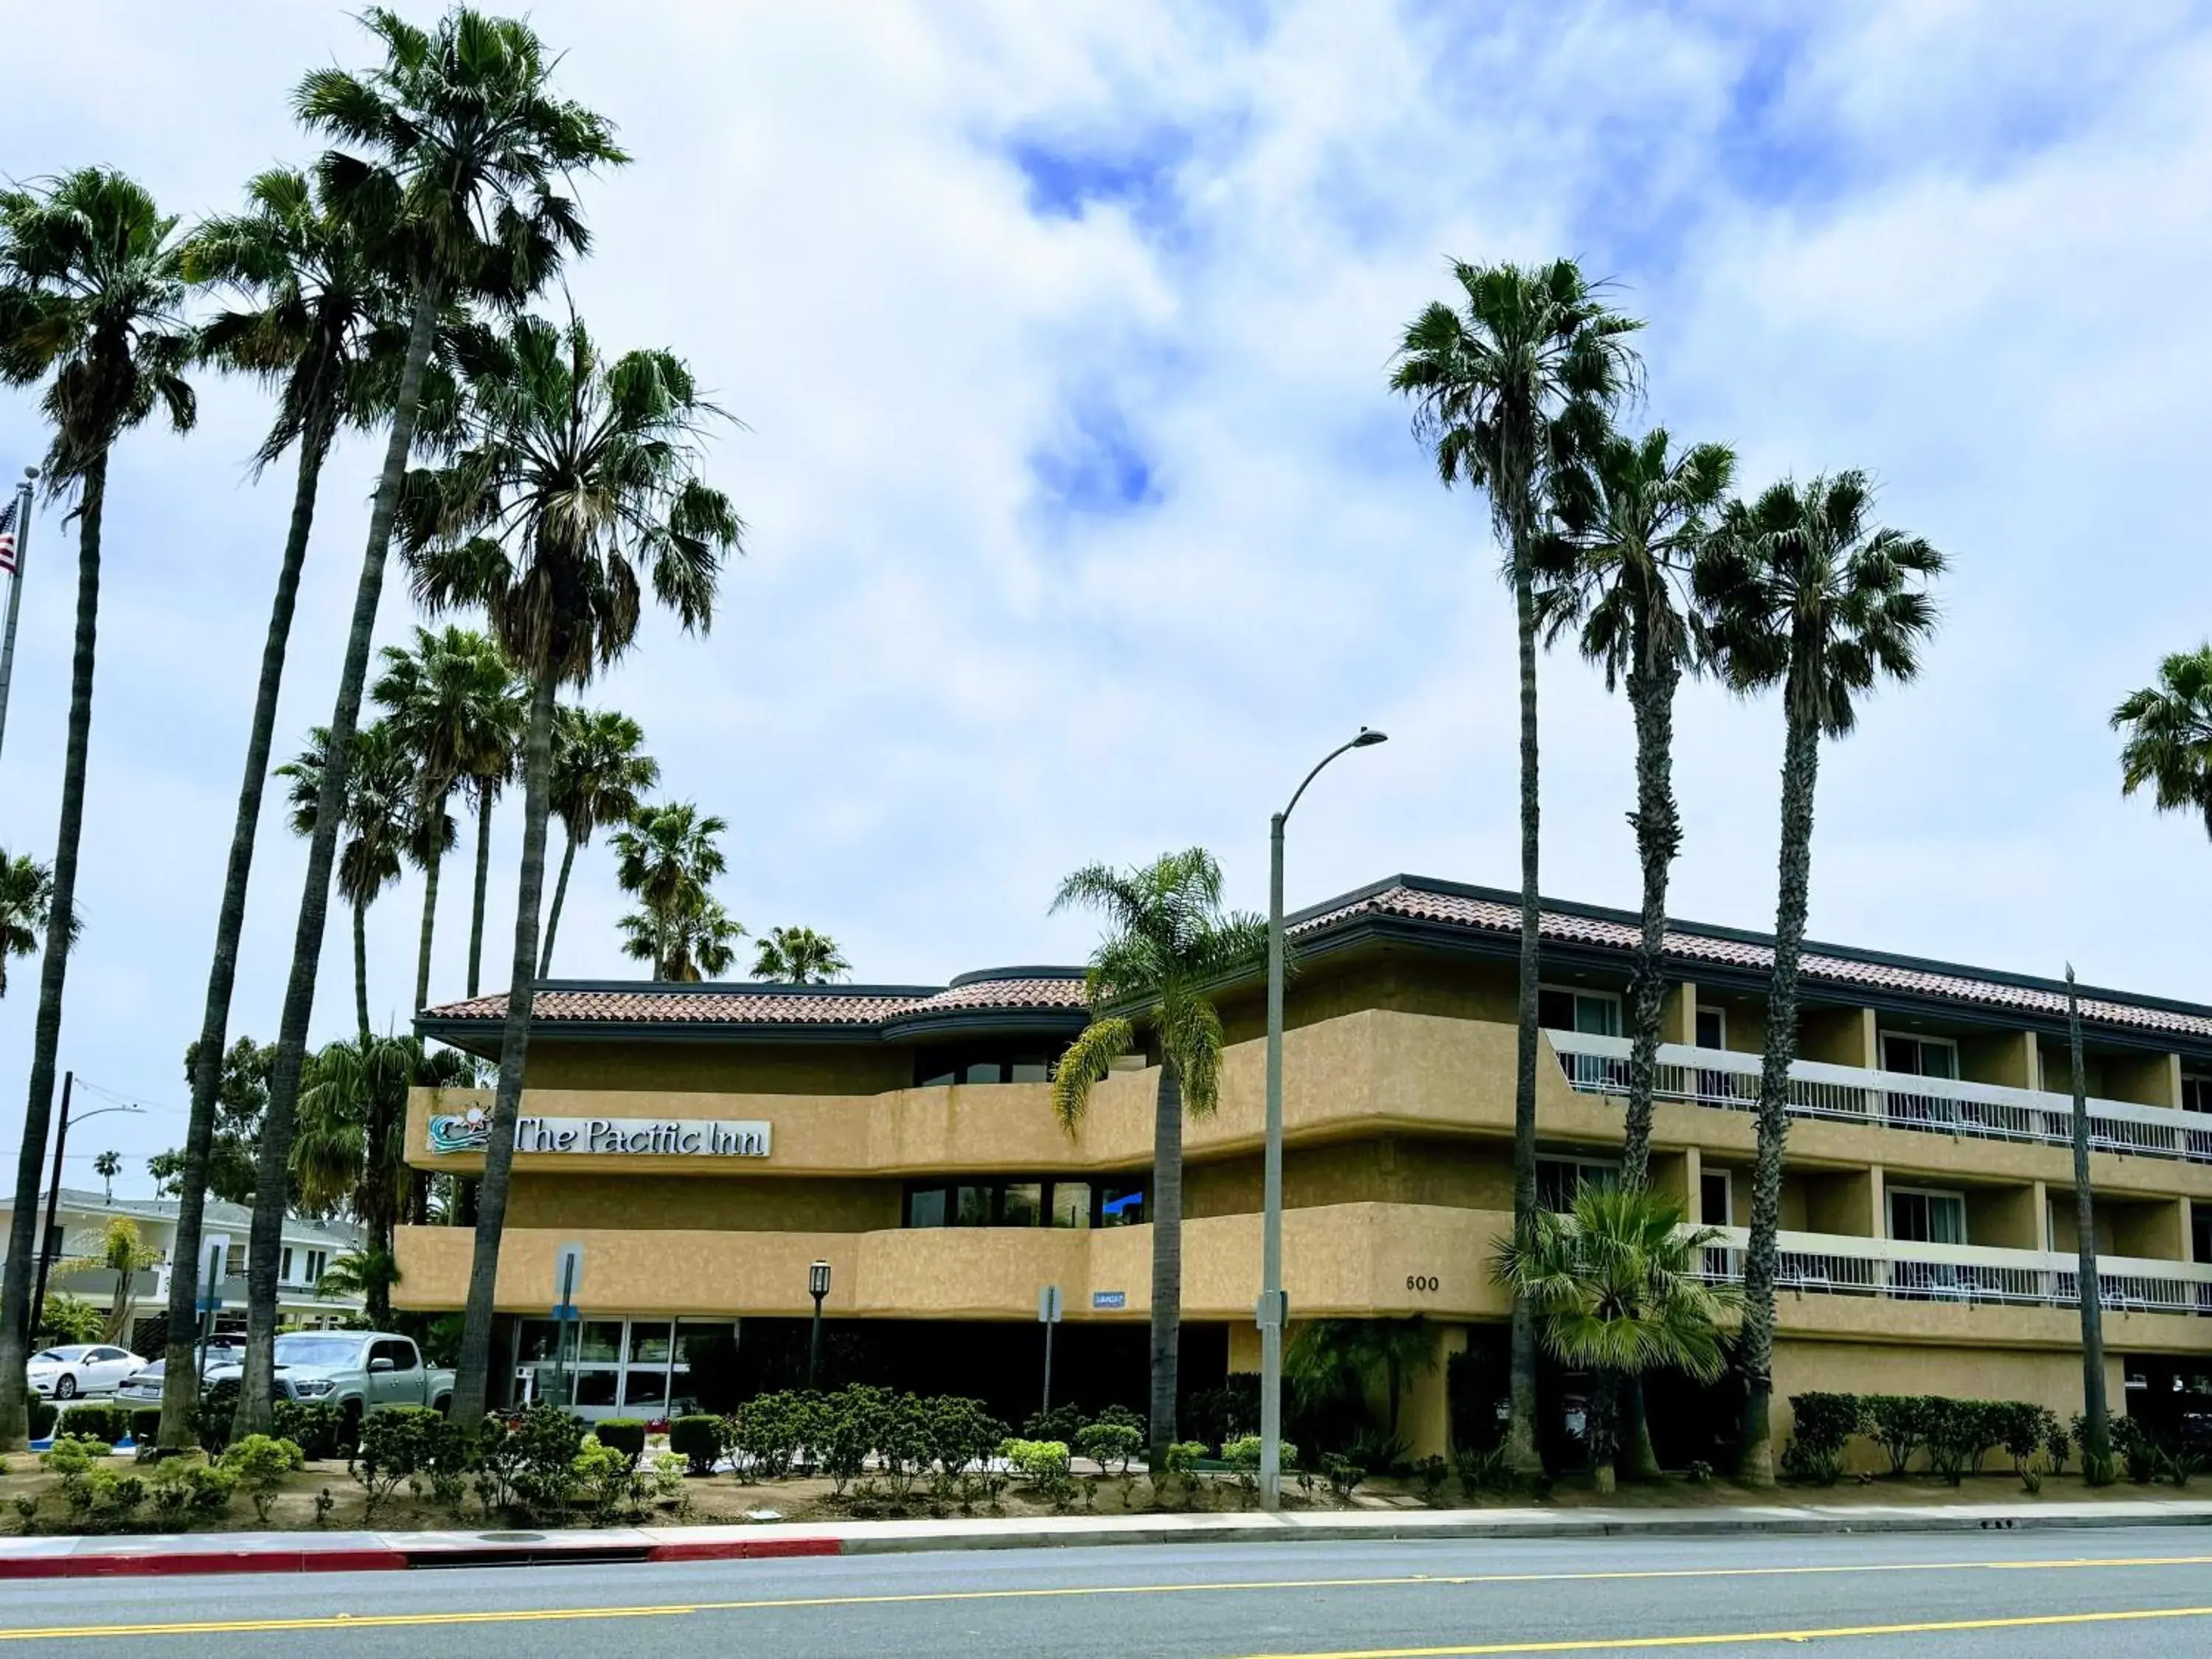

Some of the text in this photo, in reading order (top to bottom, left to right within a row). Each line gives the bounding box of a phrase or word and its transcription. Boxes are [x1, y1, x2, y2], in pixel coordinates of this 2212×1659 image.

[514, 1117, 764, 1155] The Pacific Inn
[1406, 1276, 1439, 1291] 600
